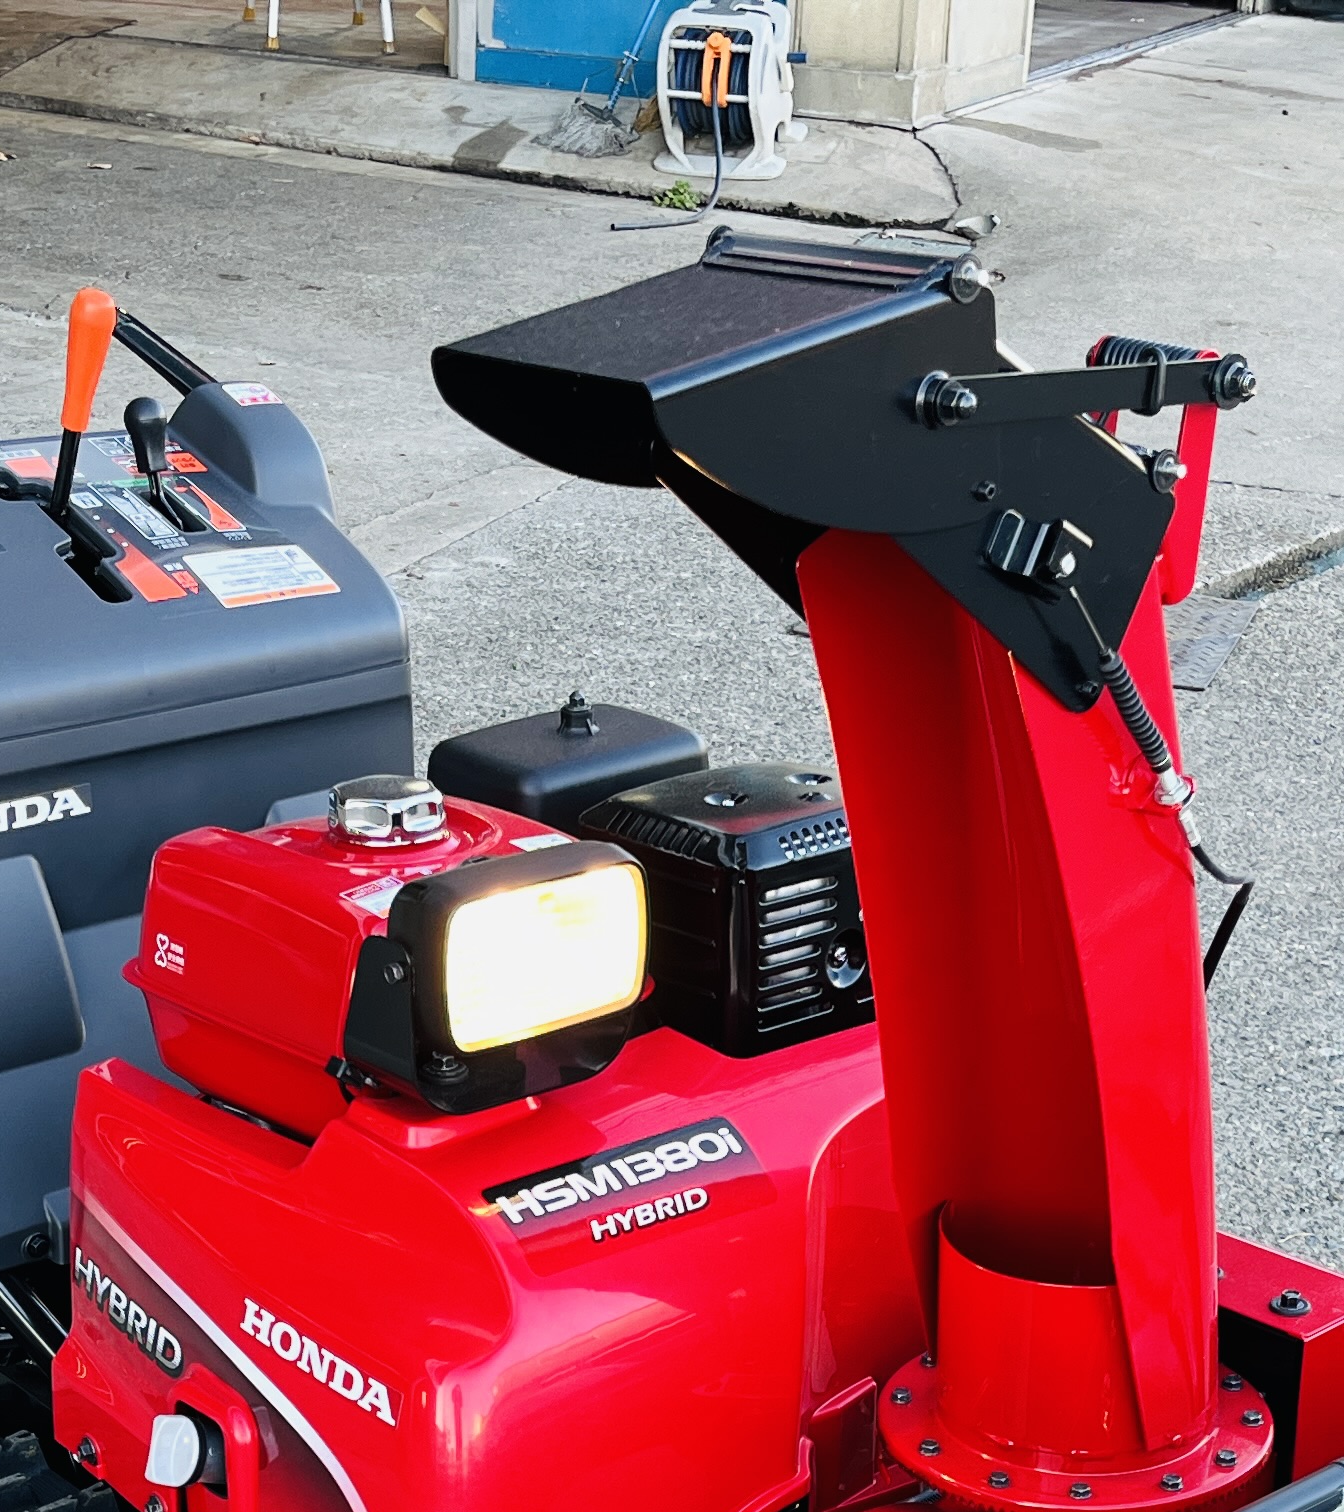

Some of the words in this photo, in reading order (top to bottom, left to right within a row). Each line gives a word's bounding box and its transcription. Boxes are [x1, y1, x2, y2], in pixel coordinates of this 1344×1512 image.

[495, 1127, 743, 1224] HSM1380i
[589, 1187, 710, 1242] HYBRID
[74, 1246, 184, 1376] HYBRID
[239, 1297, 397, 1427] HONDA
